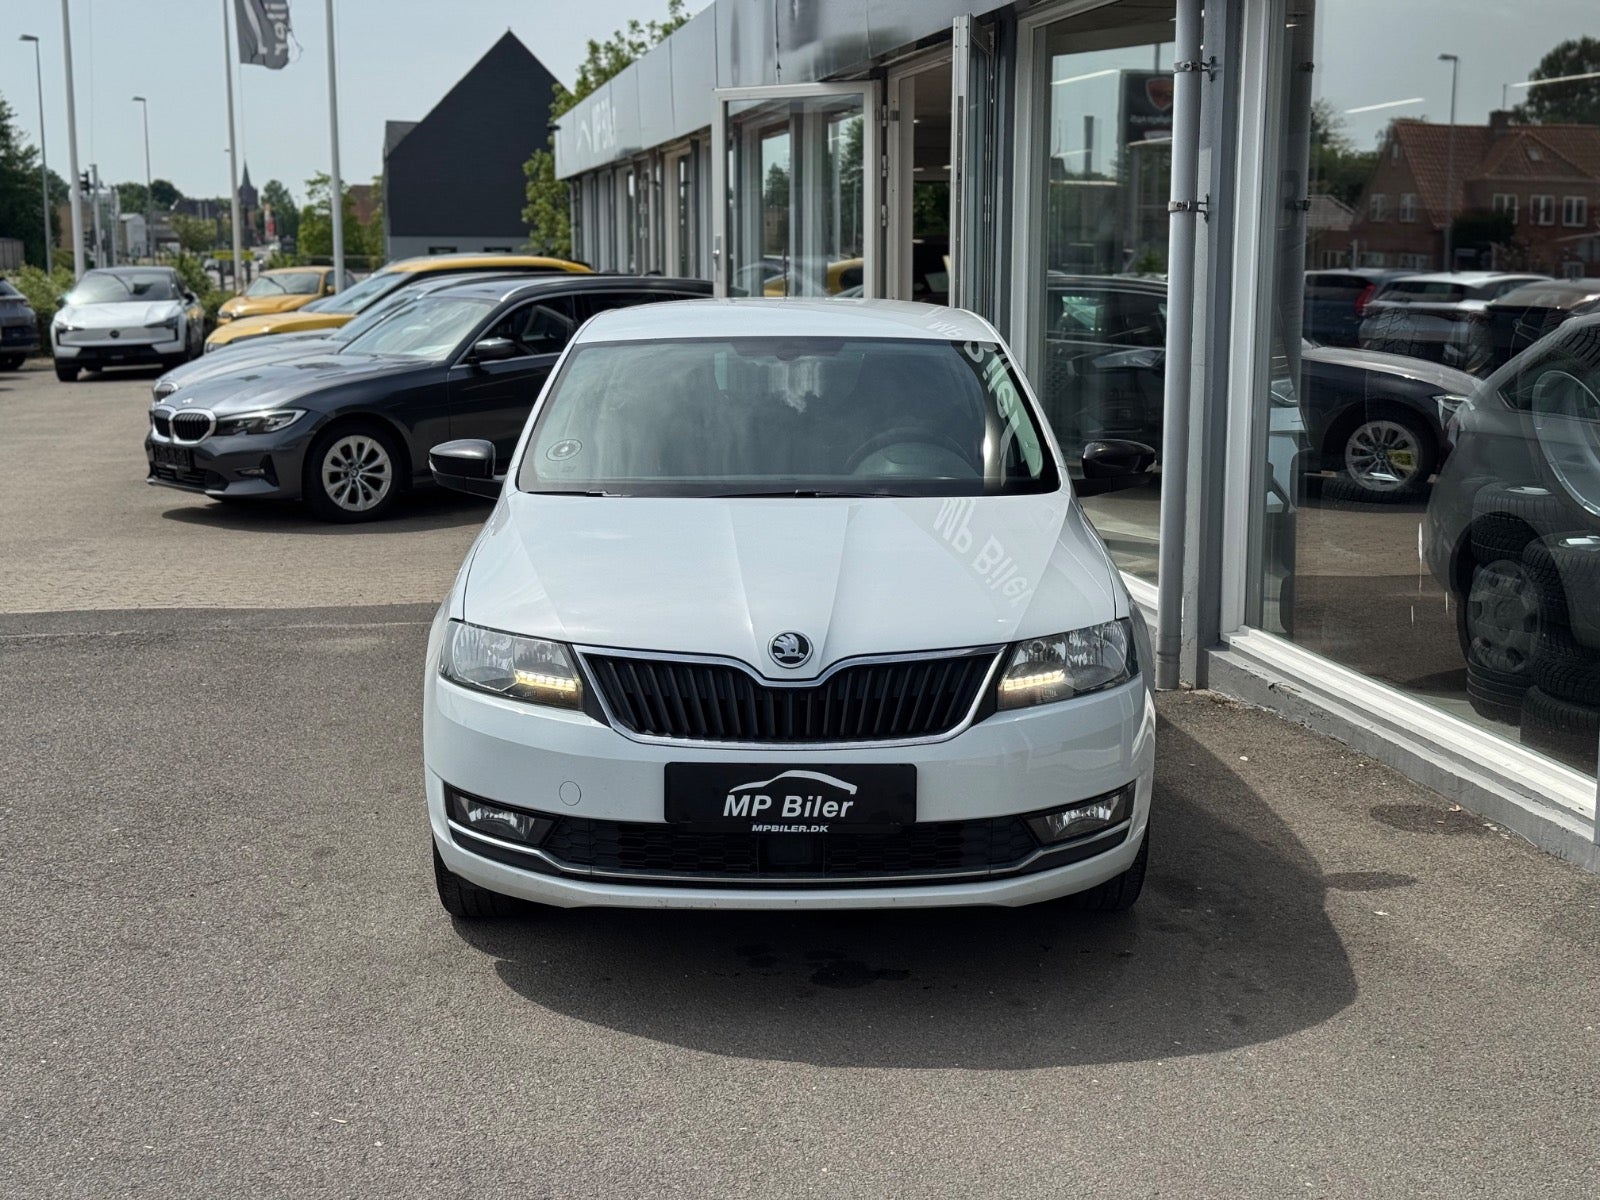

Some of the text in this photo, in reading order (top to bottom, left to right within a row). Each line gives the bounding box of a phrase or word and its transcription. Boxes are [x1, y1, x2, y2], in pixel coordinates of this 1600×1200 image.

[722, 794, 854, 818] MP Biler
[751, 824, 829, 833] MPBILER.DK
